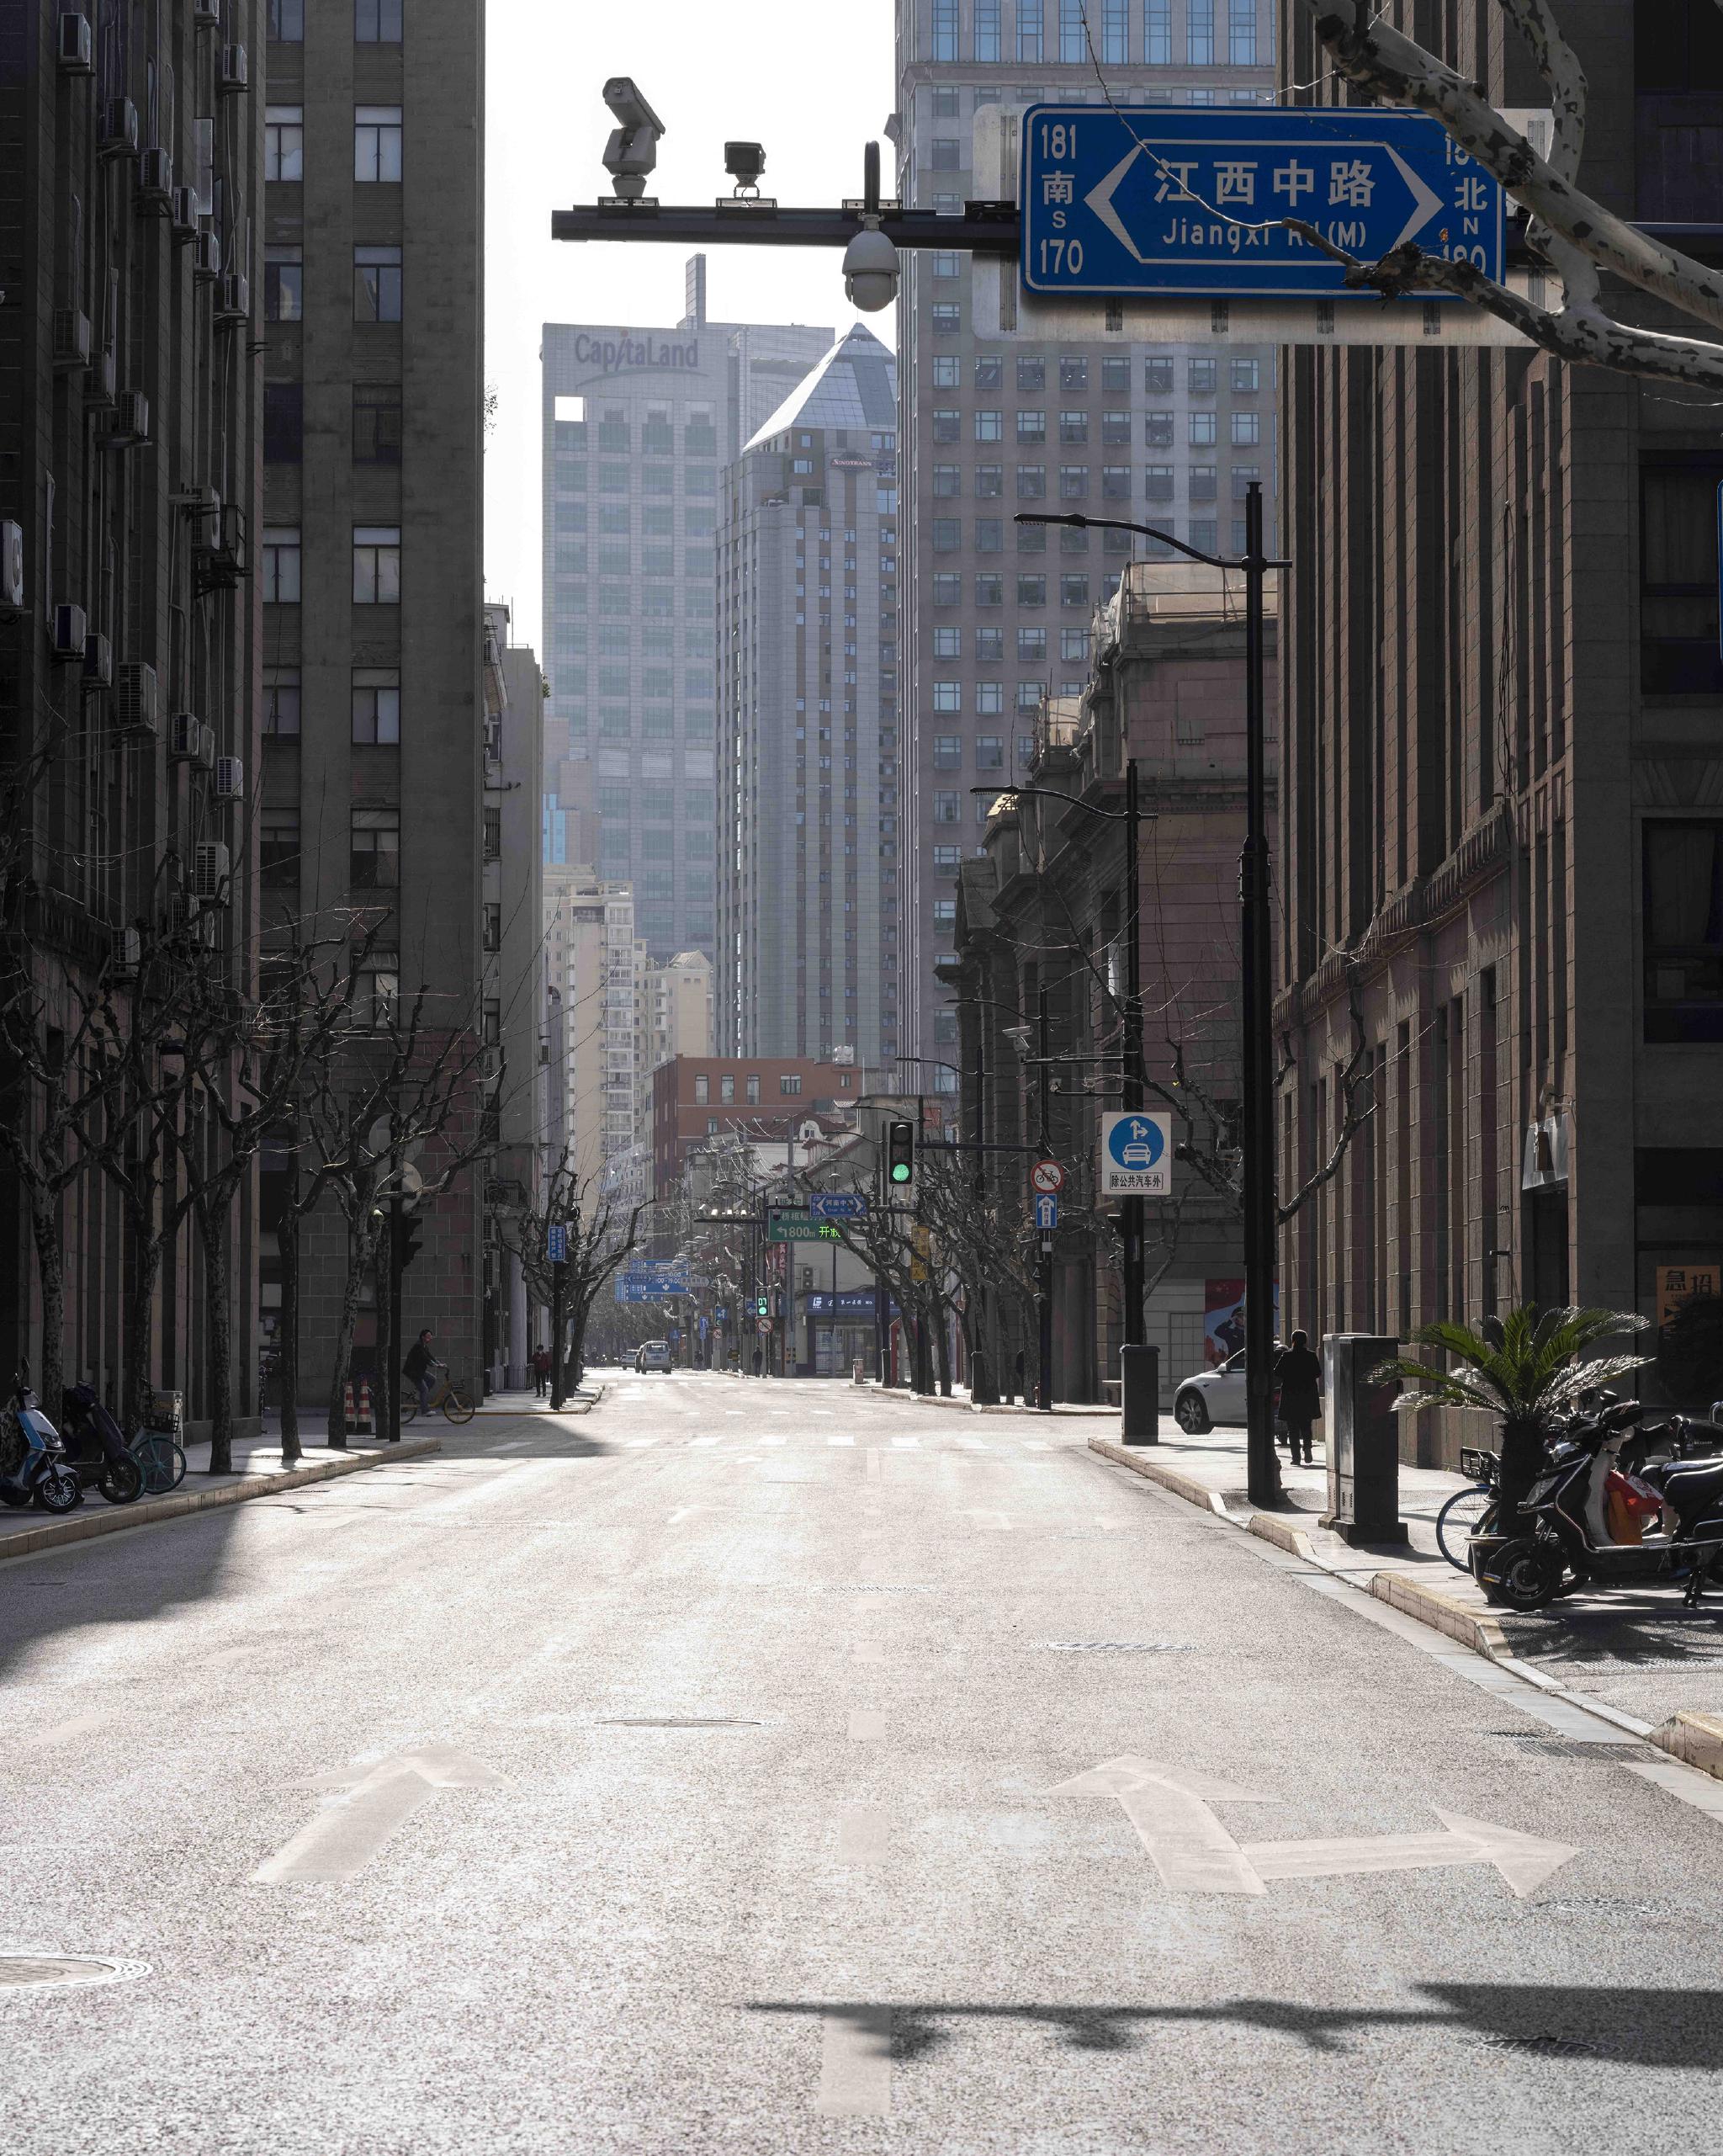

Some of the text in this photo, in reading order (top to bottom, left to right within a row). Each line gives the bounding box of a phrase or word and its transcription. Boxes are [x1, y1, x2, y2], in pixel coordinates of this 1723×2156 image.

[1042, 124, 1077, 160] 181
[1445, 131, 1481, 166] 18
[1042, 170, 1076, 205] 南
[1153, 158, 1376, 208] 江西中路
[1454, 177, 1488, 210] 北
[1051, 210, 1067, 229] S
[1163, 217, 1270, 253] Jiangxi
[1463, 217, 1479, 235] N
[1040, 239, 1084, 274] 170
[575, 330, 698, 372] CapitaLand
[1111, 1175, 1161, 1187] 除公共汽车外
[788, 1227, 815, 1238] 800m
[819, 1226, 841, 1238] 开放
[1666, 1269, 1712, 1294] 急招
